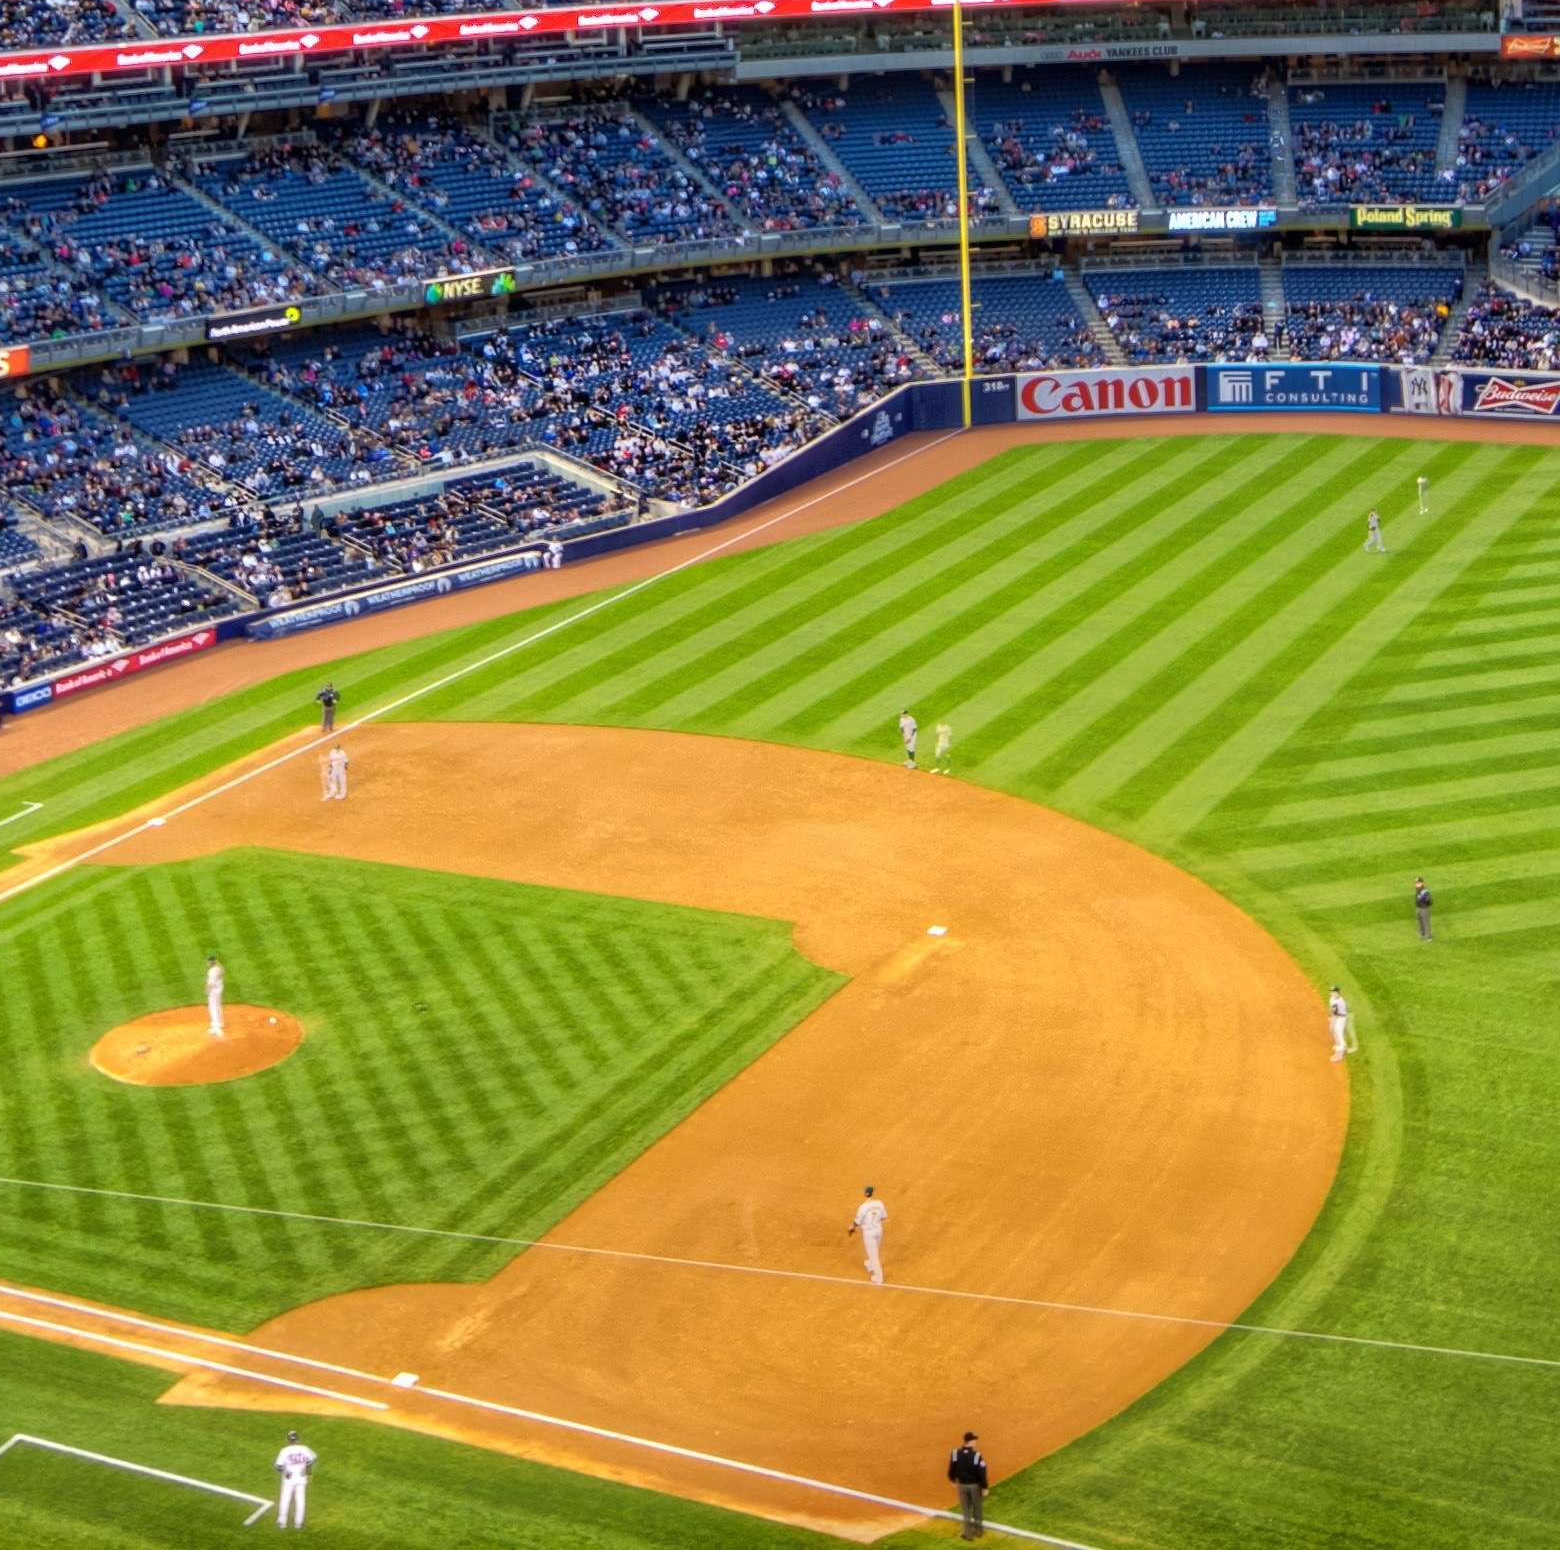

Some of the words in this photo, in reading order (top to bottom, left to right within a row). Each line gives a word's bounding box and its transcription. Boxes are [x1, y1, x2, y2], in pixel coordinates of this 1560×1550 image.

[1106, 47, 1150, 59] YANKEES
[1152, 45, 1178, 56] CLUB
[1047, 212, 1138, 231] SYRACUSE
[1168, 211, 1225, 230] AMERICAN
[1226, 210, 1257, 229] CREW
[1357, 209, 1403, 228] Poland
[1406, 208, 1453, 229] Spring
[442, 278, 483, 300] NYSE
[1021, 375, 1193, 415] Canon
[1265, 391, 1369, 405] CONSULTING
[15, 685, 52, 707] GEICO
